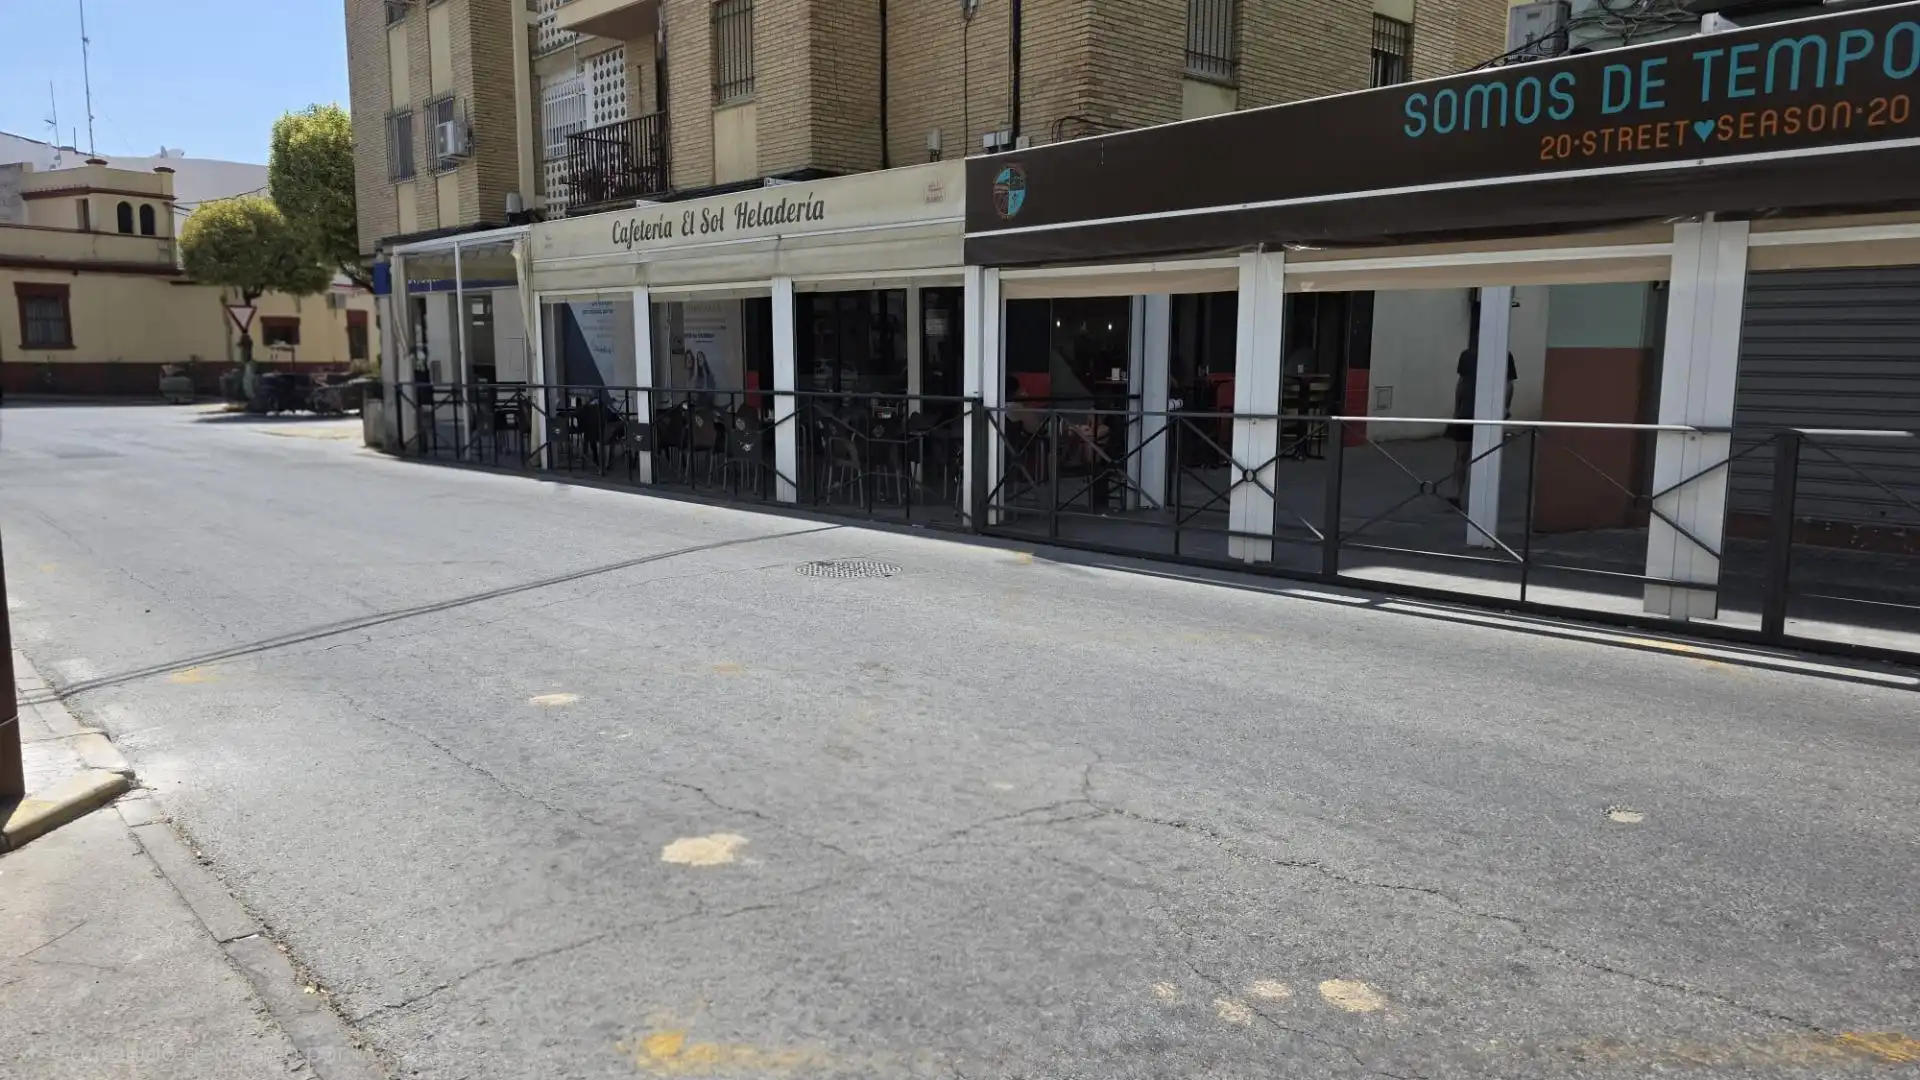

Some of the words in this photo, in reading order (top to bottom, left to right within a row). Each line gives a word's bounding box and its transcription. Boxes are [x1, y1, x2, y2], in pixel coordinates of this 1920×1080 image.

[1404, 71, 1576, 138] SOMOS
[1601, 57, 1668, 114] DE
[1693, 21, 1920, 102] TEMPO
[612, 214, 673, 251] Cafetería
[681, 210, 695, 237] El
[700, 207, 725, 234] Sol
[734, 191, 825, 230] Heladería
